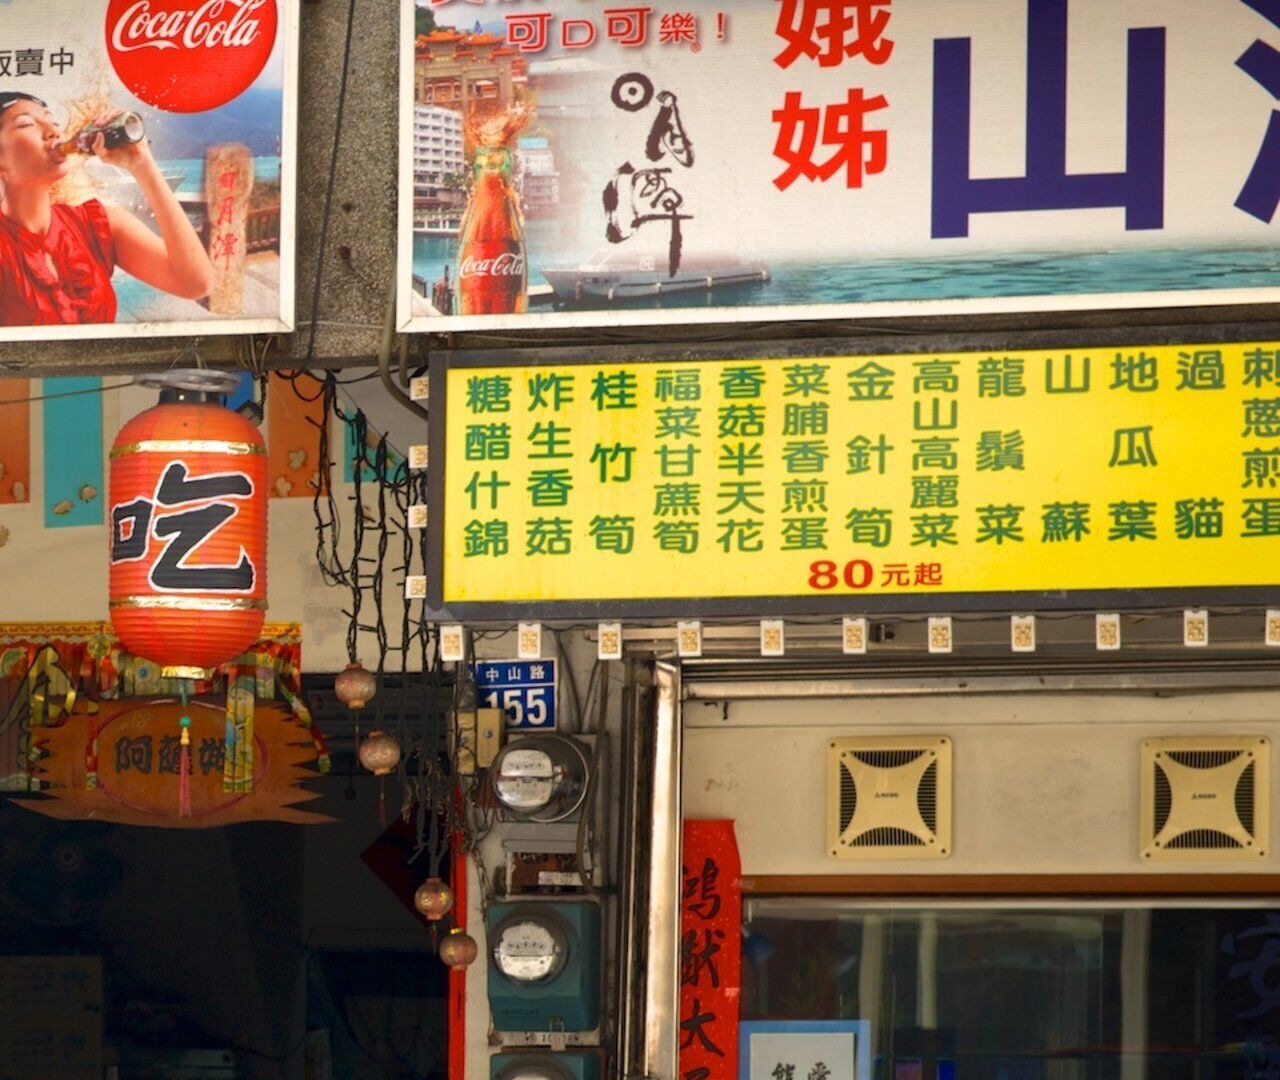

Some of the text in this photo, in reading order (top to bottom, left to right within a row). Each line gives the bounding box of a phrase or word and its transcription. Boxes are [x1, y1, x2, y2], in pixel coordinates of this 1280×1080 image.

[459, 252, 525, 281] Coca-Cola
[111, 459, 256, 594] 吃
[463, 376, 512, 559] 糖醋什錦
[526, 373, 575, 557] 炸生香菇
[589, 370, 638, 557] 桂竹筍
[653, 368, 702, 555] 福菜甘蔗筍
[716, 365, 767, 555] 香菇半天花
[780, 363, 831, 552] 菜脯香煎蛋
[844, 361, 895, 549] 金針筍
[910, 358, 961, 549] 高山高麗菜
[974, 357, 1027, 545] 龍鬚菜
[1039, 355, 1092, 544] 山蘇
[1107, 352, 1159, 543] 地瓜葉
[485, 665, 545, 682] 中山路
[486, 688, 547, 726] 155
